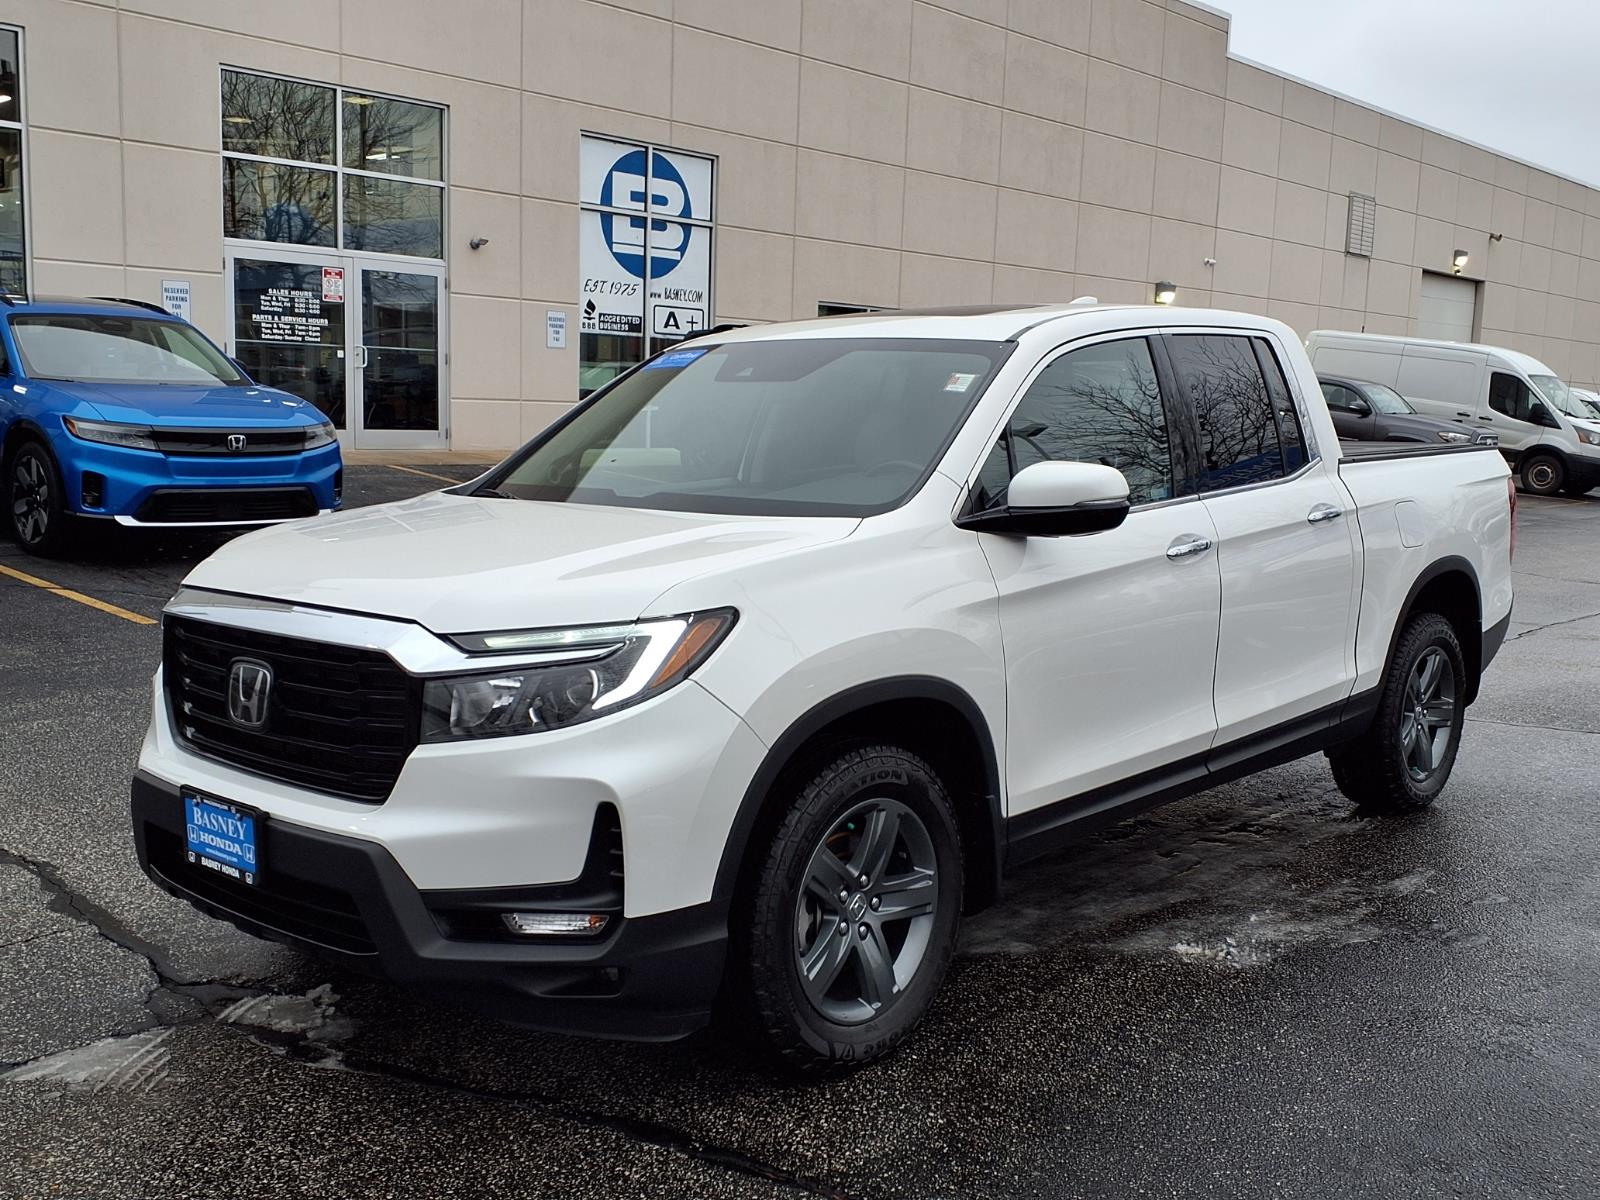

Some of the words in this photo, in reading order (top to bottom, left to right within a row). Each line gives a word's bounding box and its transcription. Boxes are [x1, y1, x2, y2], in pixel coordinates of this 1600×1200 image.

[609, 281, 640, 296] 1975
[280, 315, 306, 323] SERVICE
[599, 314, 641, 324] ACCREDITED
[599, 322, 629, 331] BUSINESS
[193, 806, 246, 840] BASNEY
[200, 831, 243, 856] HONDA
[201, 856, 221, 872] BASNEY
[221, 863, 240, 878] HONDA
